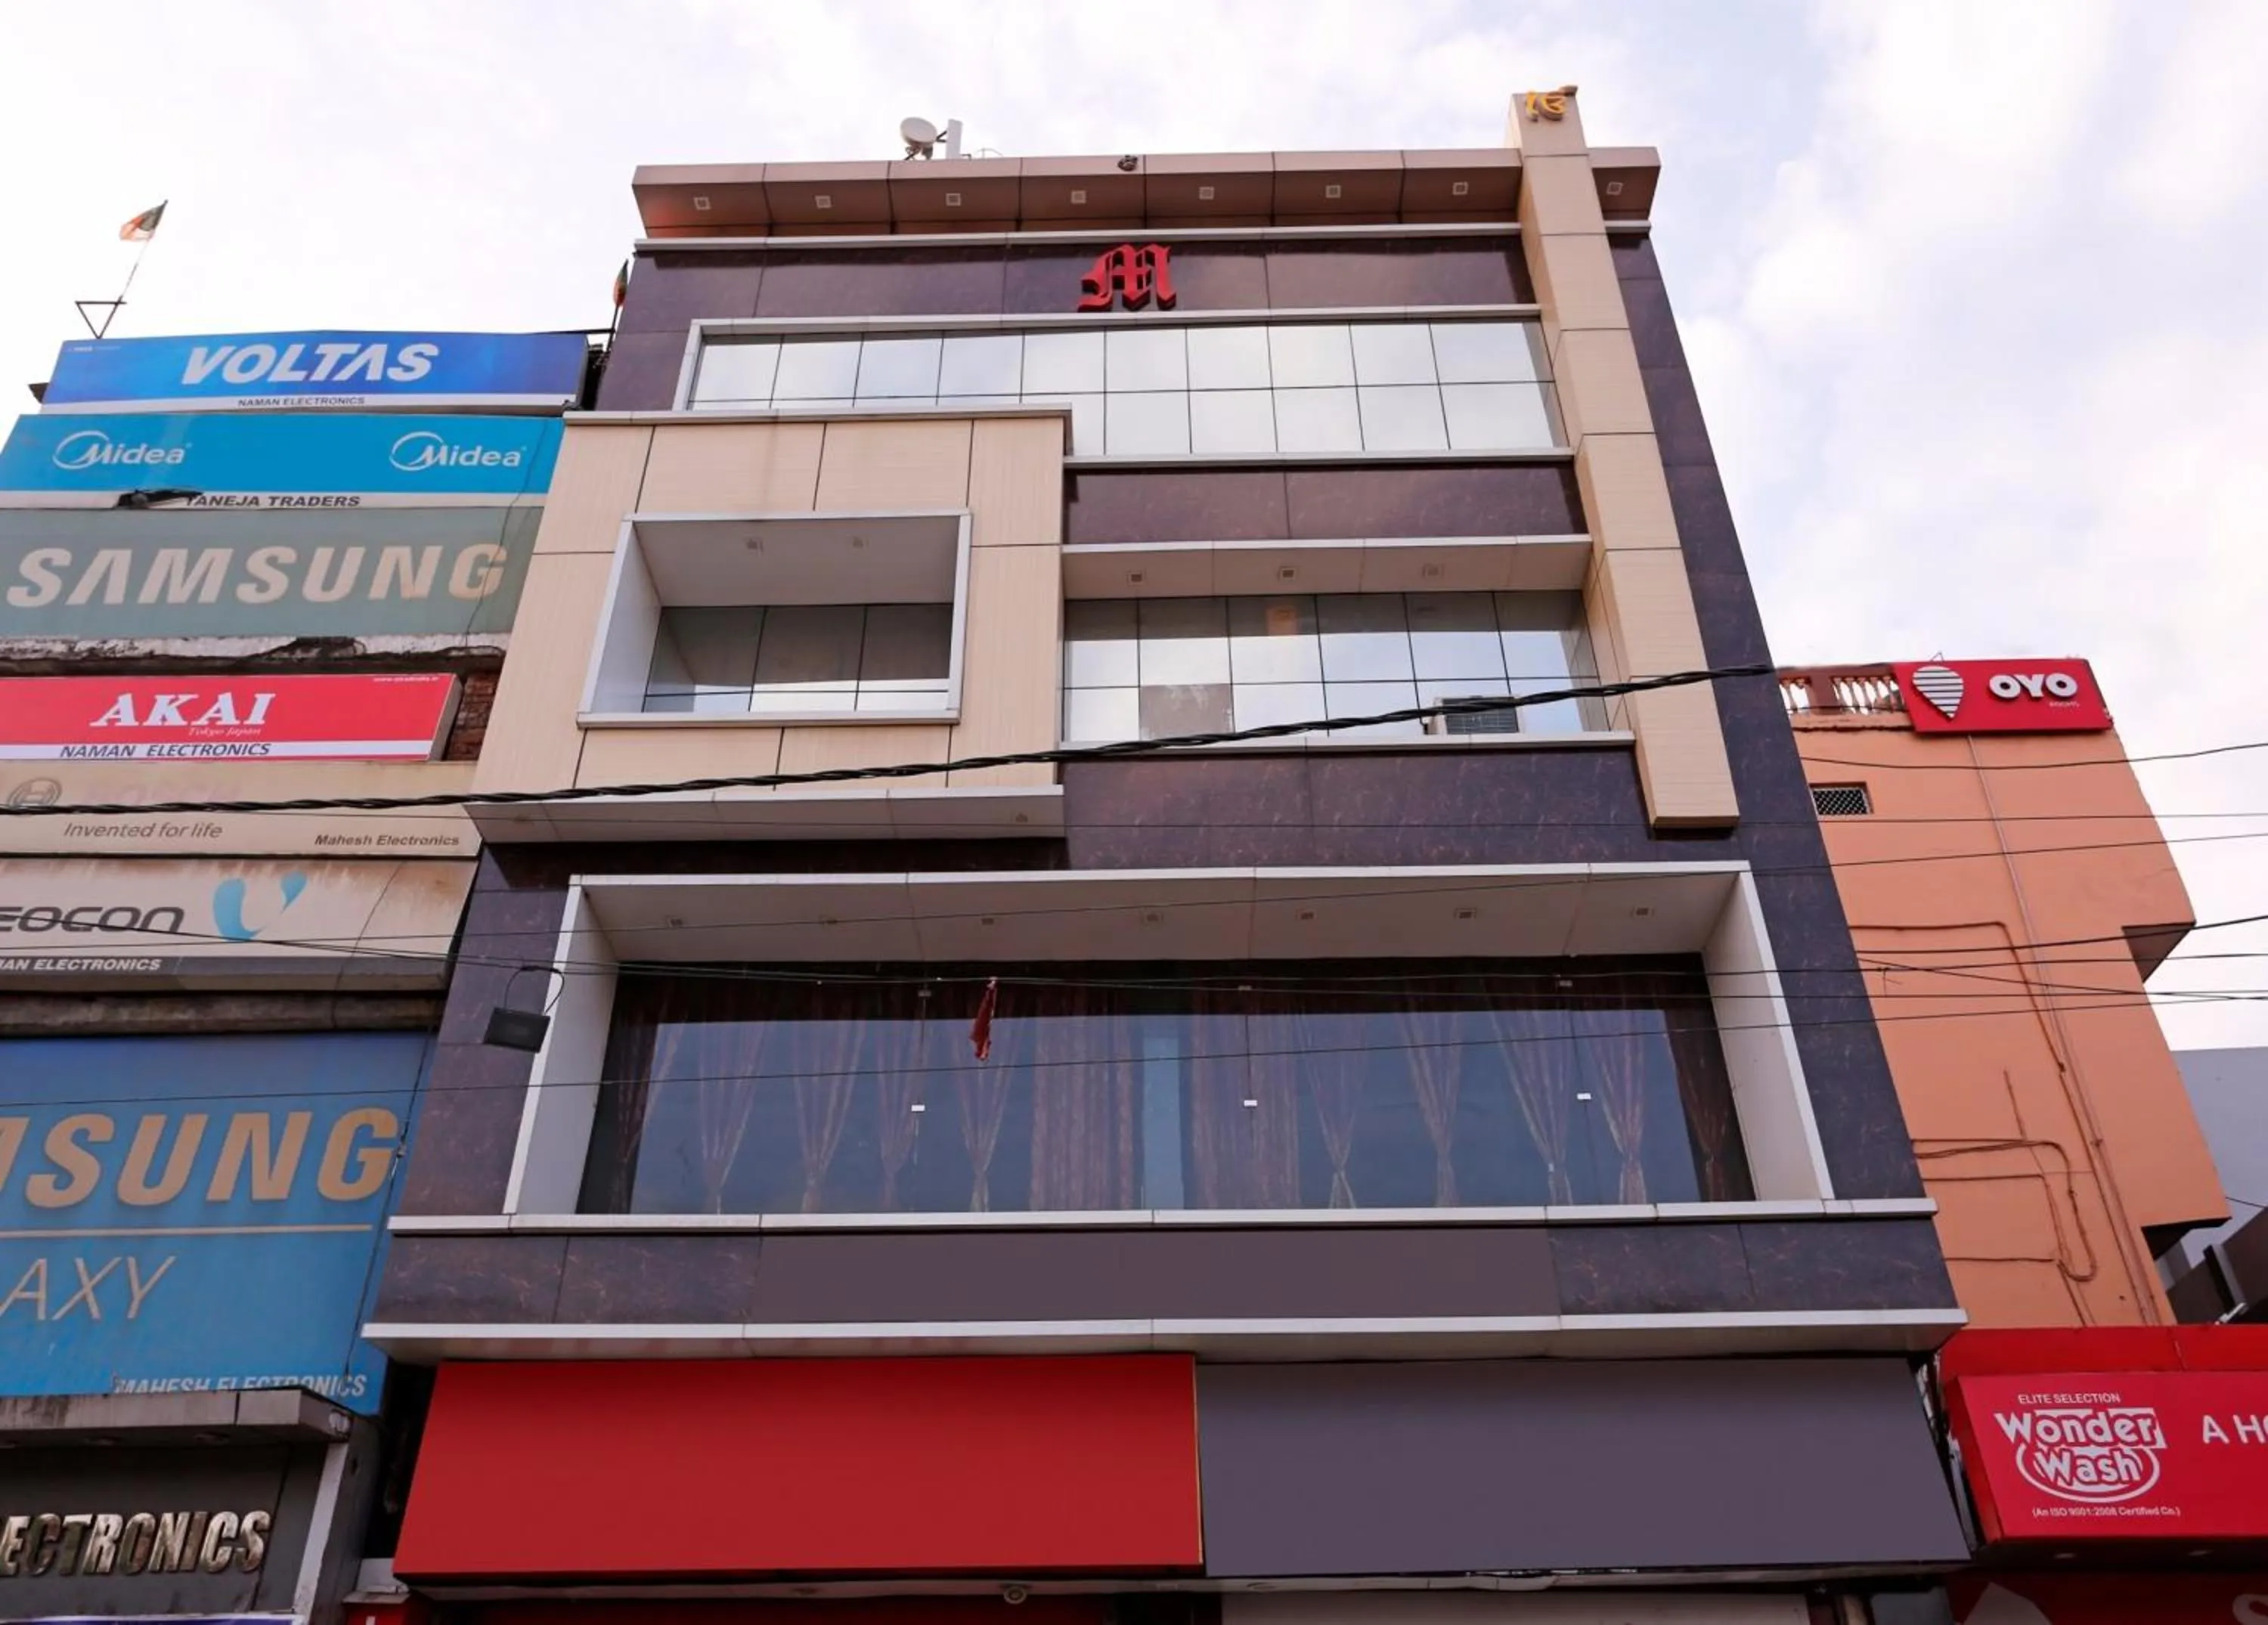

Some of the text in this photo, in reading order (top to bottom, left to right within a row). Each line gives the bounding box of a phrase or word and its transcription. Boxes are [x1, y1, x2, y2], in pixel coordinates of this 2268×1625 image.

[181, 343, 439, 385] VOLTAS
[237, 397, 366, 407] NAMAN ELECTRONICS
[52, 430, 185, 469] Midea
[389, 431, 522, 471] Midea
[186, 495, 361, 507] TANEJA TRADERS
[6, 544, 507, 608] SAMSUNG
[1989, 673, 2078, 699] OYO
[89, 692, 276, 727] AKAI
[60, 743, 272, 758] NAMAN ELECTRONICS
[64, 822, 223, 839] Invented for life
[314, 834, 460, 846] Mahesh Electronics
[0, 958, 163, 971] AN ELECTRONICS
[0, 1255, 178, 1320] AXY
[2018, 1392, 2121, 1404] ELITE SELECTION
[1994, 1410, 2153, 1444] Wonder
[2202, 1414, 2268, 1444] A H
[2034, 1450, 2141, 1484] Wash
[0, 1510, 271, 1577] ECTRONICS
